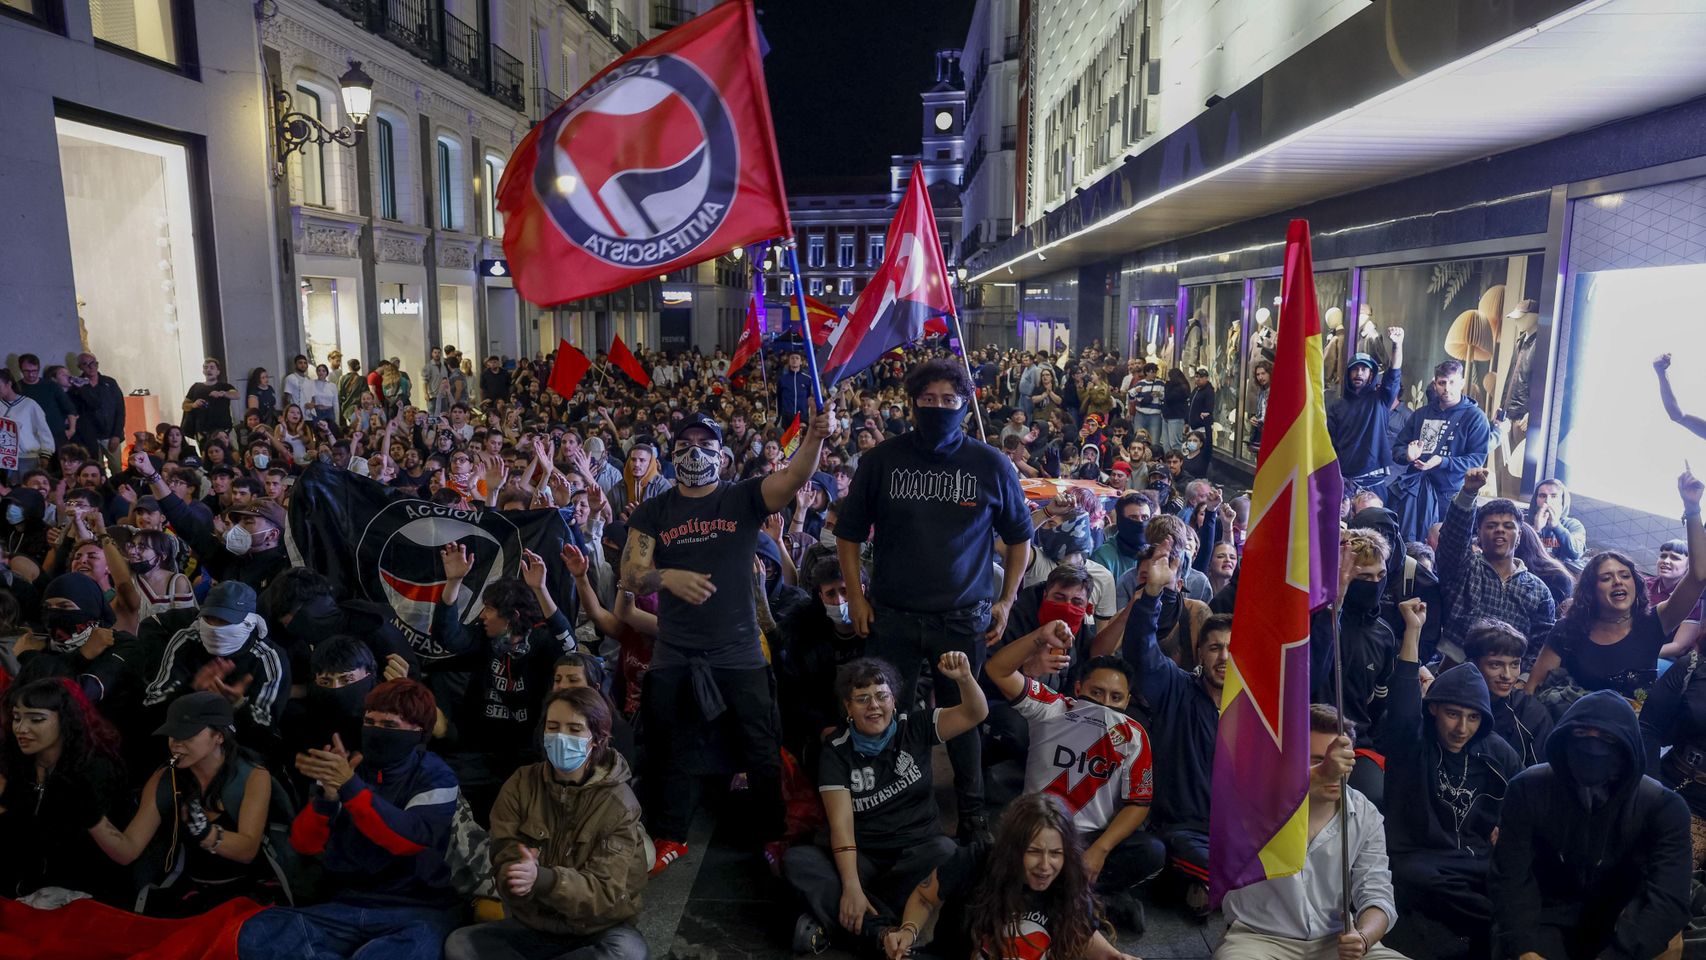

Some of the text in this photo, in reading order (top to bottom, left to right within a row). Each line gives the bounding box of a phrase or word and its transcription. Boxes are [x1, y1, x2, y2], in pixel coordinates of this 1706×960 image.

[659, 517, 737, 547] hooligans
[485, 704, 528, 722] STRNG
[1053, 744, 1117, 779] DIGI
[851, 766, 875, 793] 96
